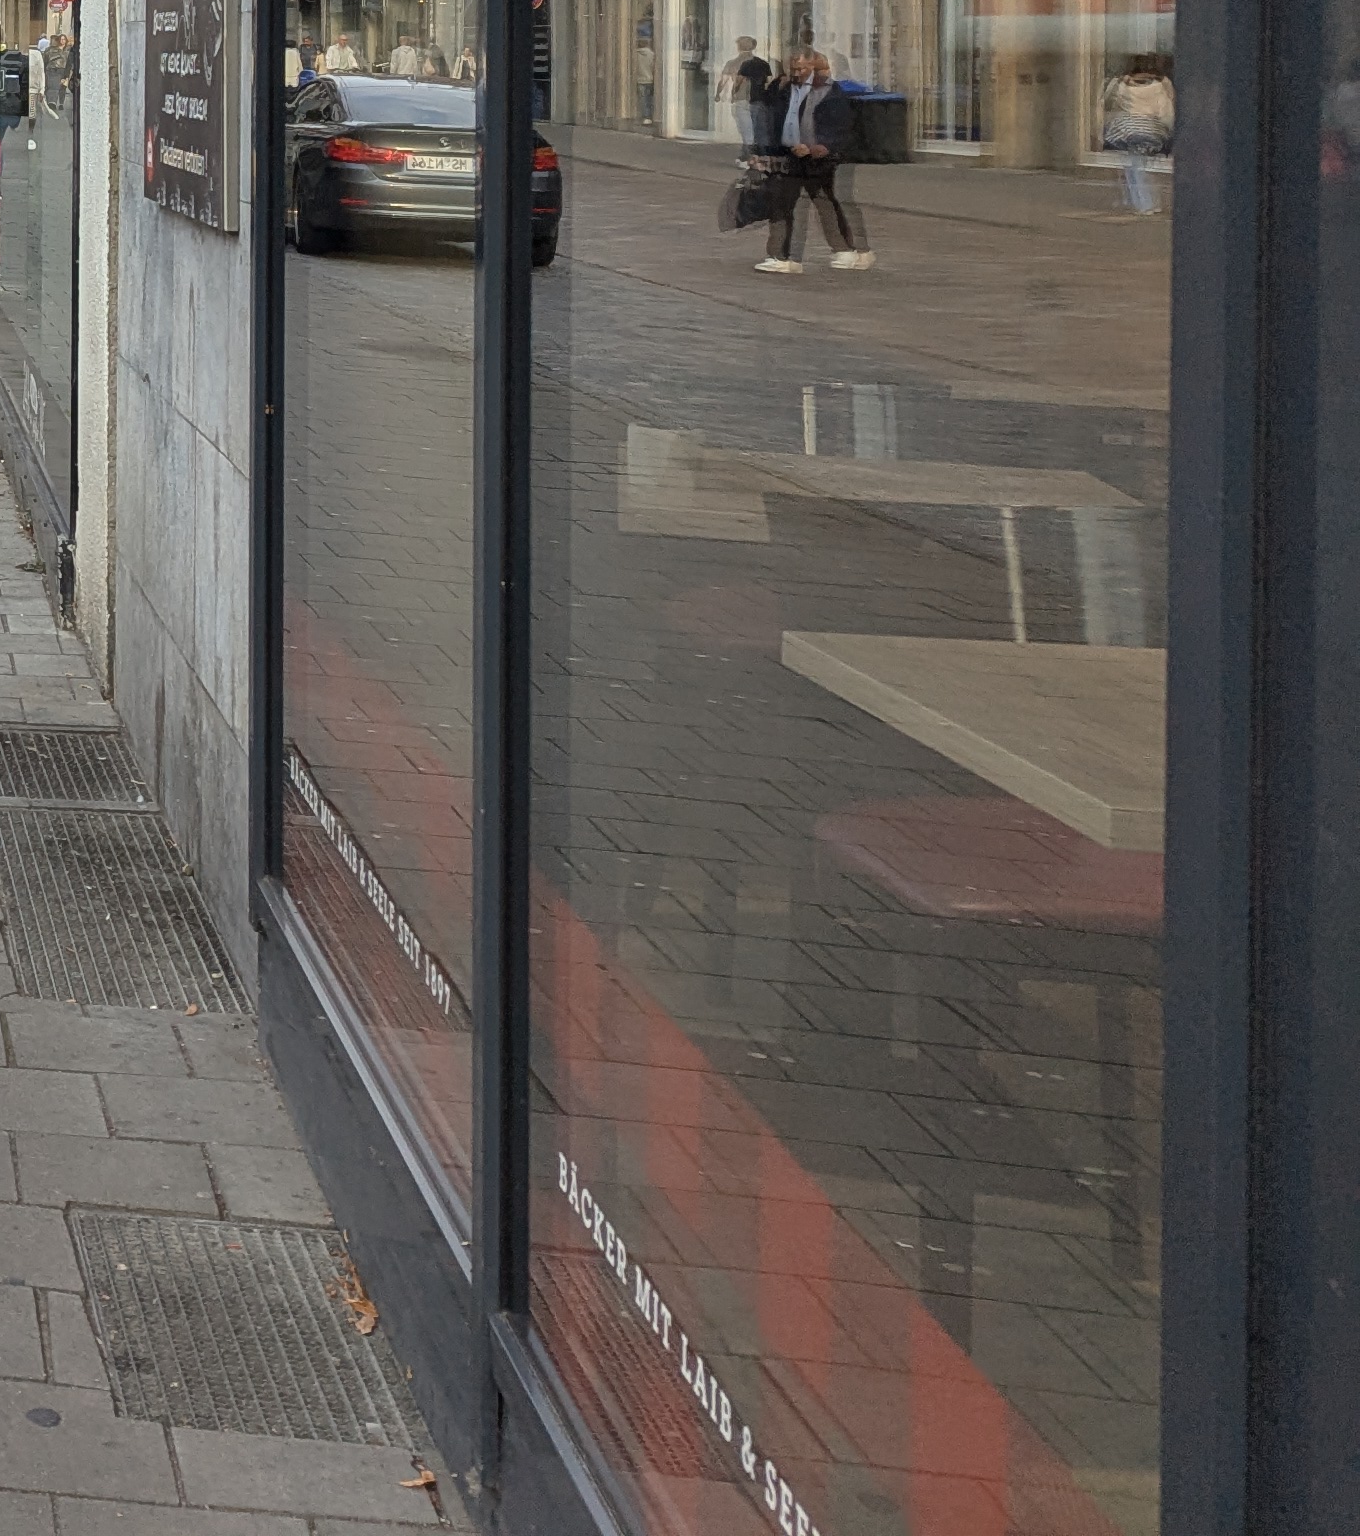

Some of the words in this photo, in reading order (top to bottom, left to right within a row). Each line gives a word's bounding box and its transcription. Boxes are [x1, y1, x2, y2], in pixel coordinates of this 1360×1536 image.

[290, 755, 319, 817] BÄCKER
[320, 799, 336, 841] MIT
[337, 824, 358, 874] LAIB
[359, 857, 366, 887] &
[368, 870, 396, 932] SEELE
[398, 914, 421, 970] SEIT
[425, 954, 451, 1015] 1897
[558, 1151, 627, 1284] BÄCKER
[635, 1265, 672, 1350] MIT
[680, 1333, 732, 1443] LAIB
[741, 1425, 757, 1481] &
[765, 1460, 821, 1536] SEE
